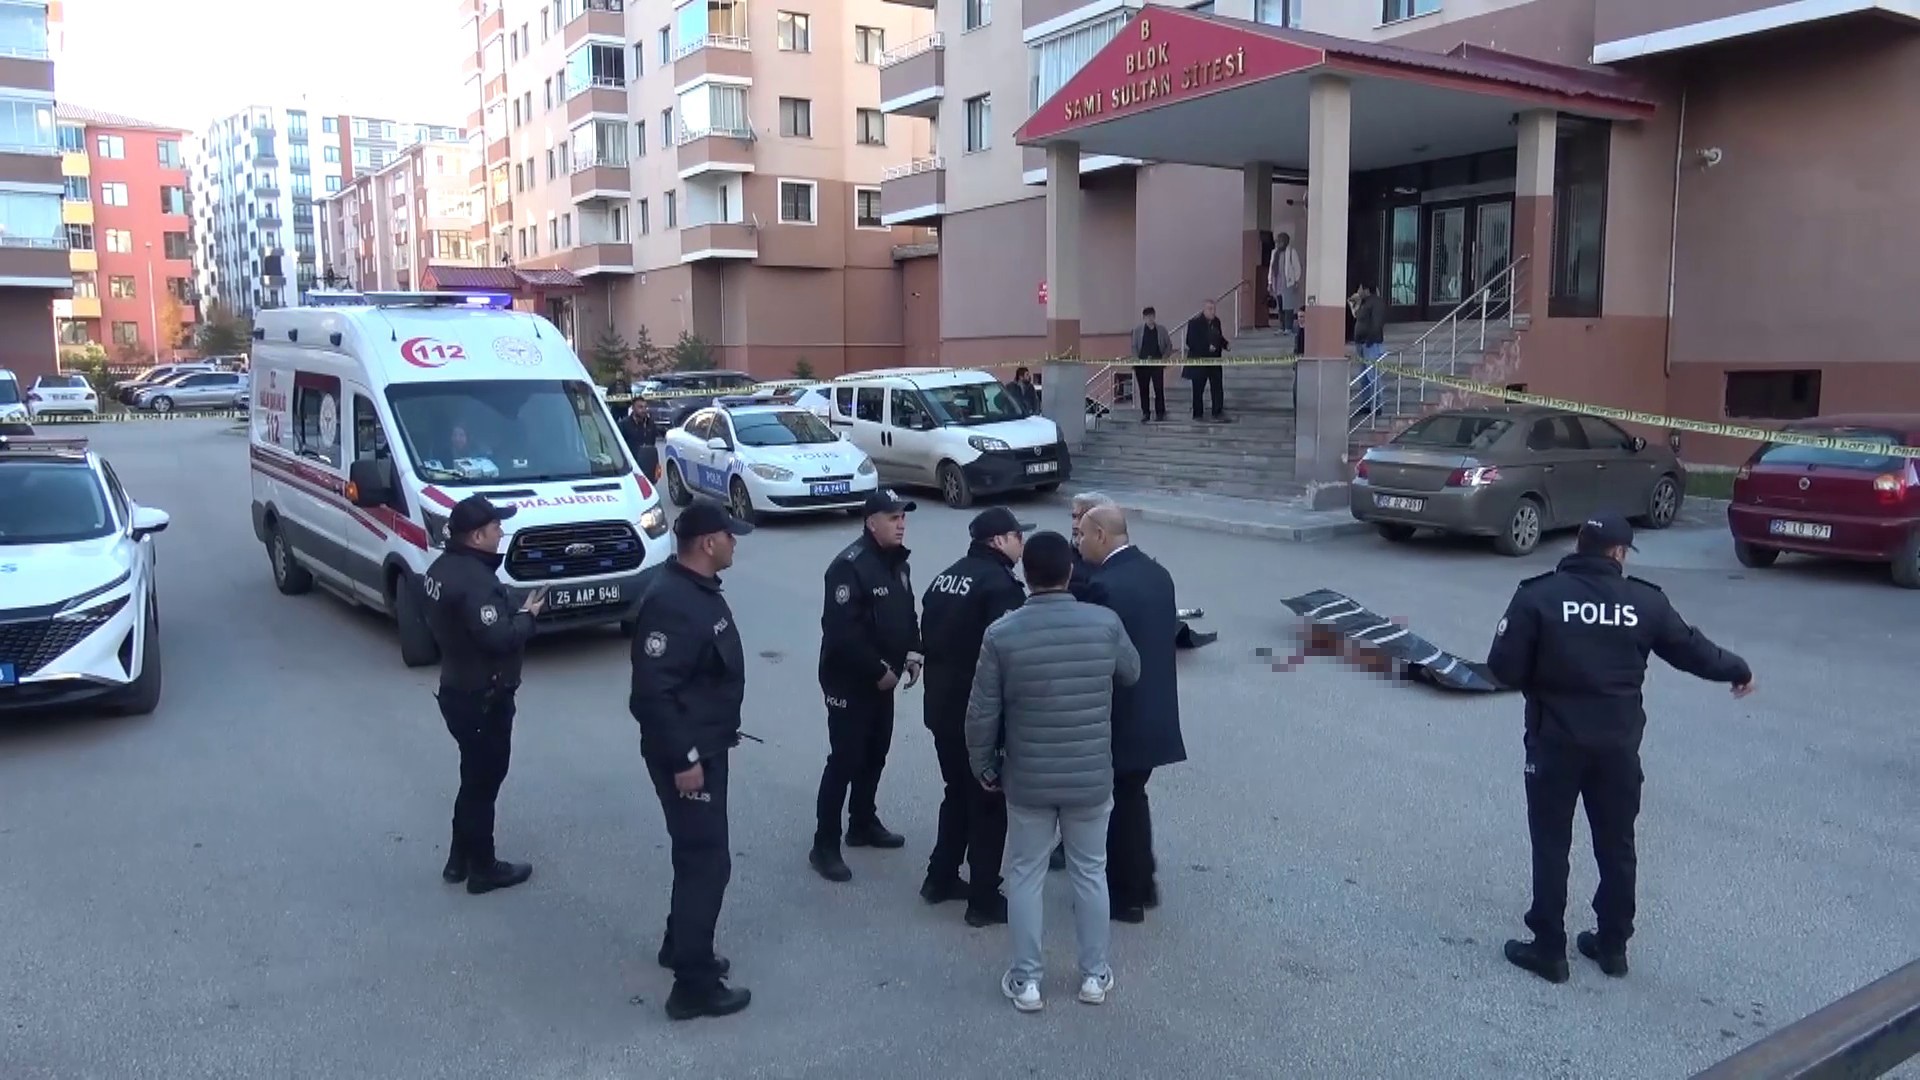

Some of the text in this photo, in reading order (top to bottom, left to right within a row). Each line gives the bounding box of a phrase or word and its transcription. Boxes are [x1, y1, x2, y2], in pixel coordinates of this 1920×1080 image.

[1141, 19, 1150, 40] B
[1126, 41, 1169, 75] BLOK
[1064, 88, 1102, 121] SAMİ
[1111, 71, 1172, 110] SULTAN
[415, 345, 466, 360] 112
[556, 591, 571, 605] 25
[576, 588, 596, 603] AAP
